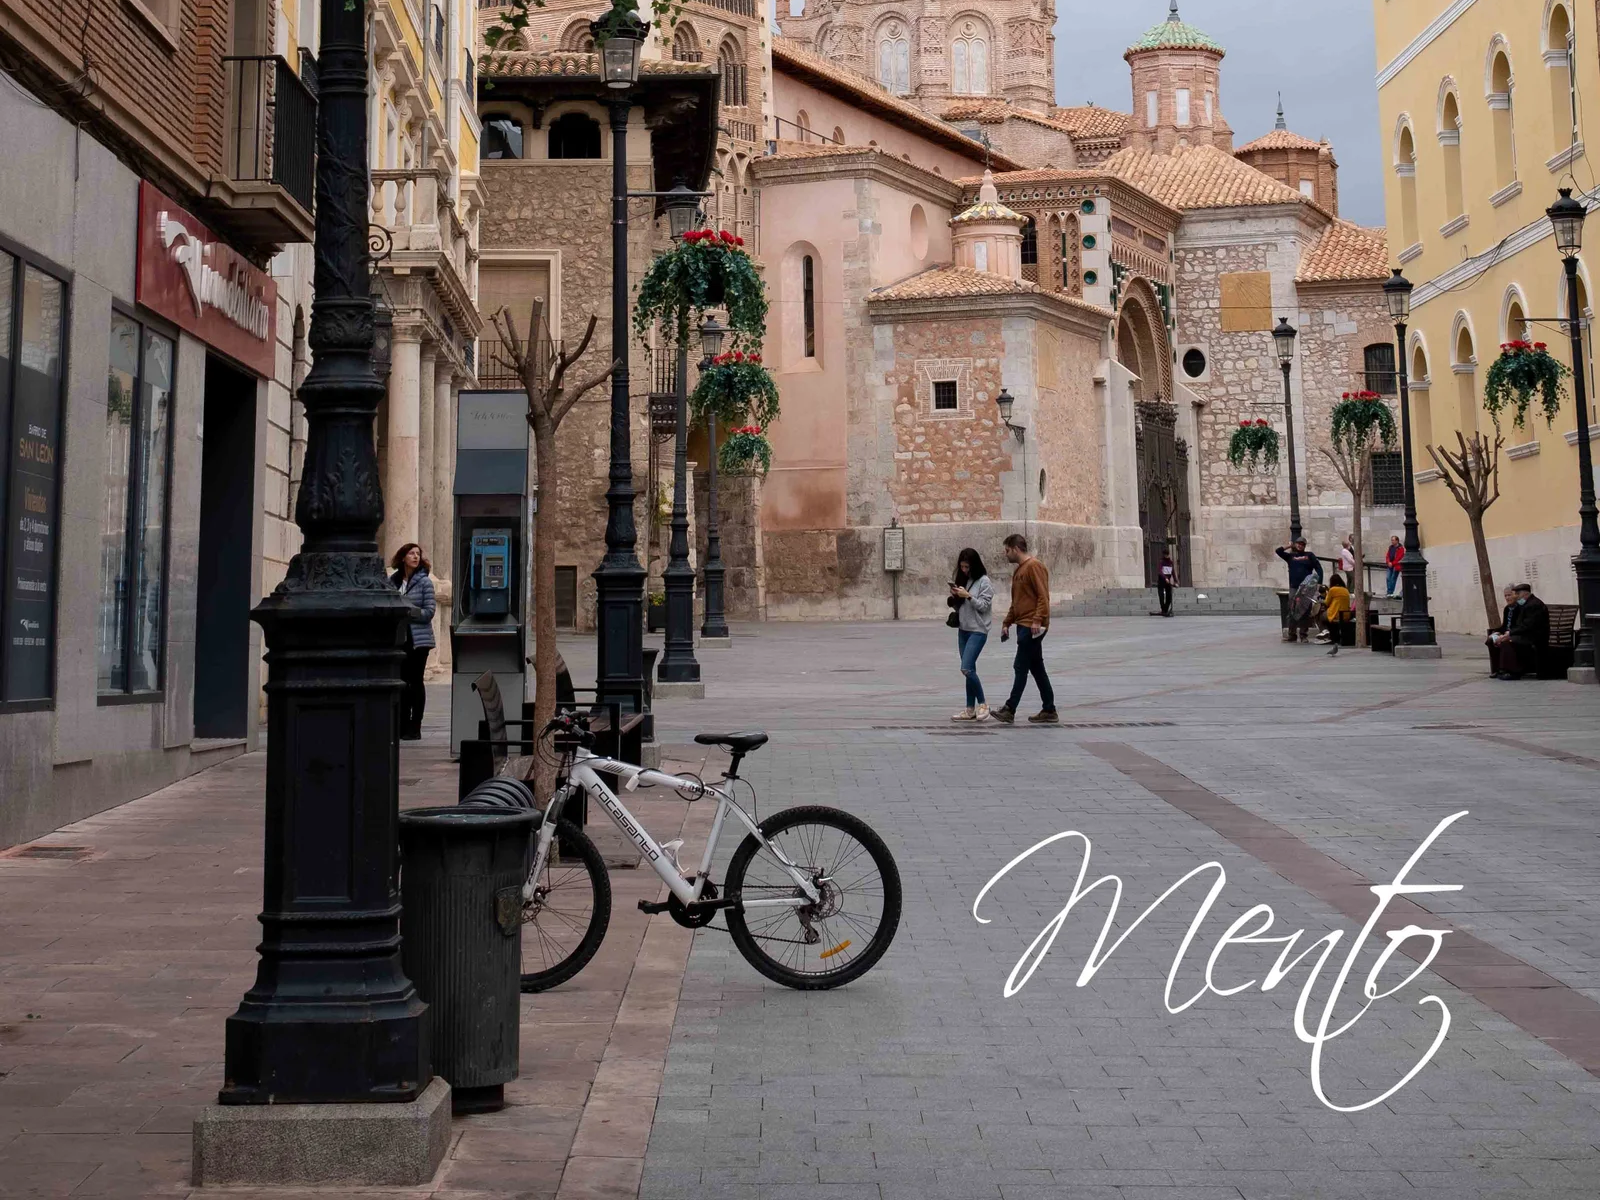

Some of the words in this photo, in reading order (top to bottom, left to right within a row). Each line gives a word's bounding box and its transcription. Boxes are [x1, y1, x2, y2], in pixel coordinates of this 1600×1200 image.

[41, 428, 47, 439] DE
[20, 437, 34, 459] SAN
[591, 782, 660, 862] rocasanto
